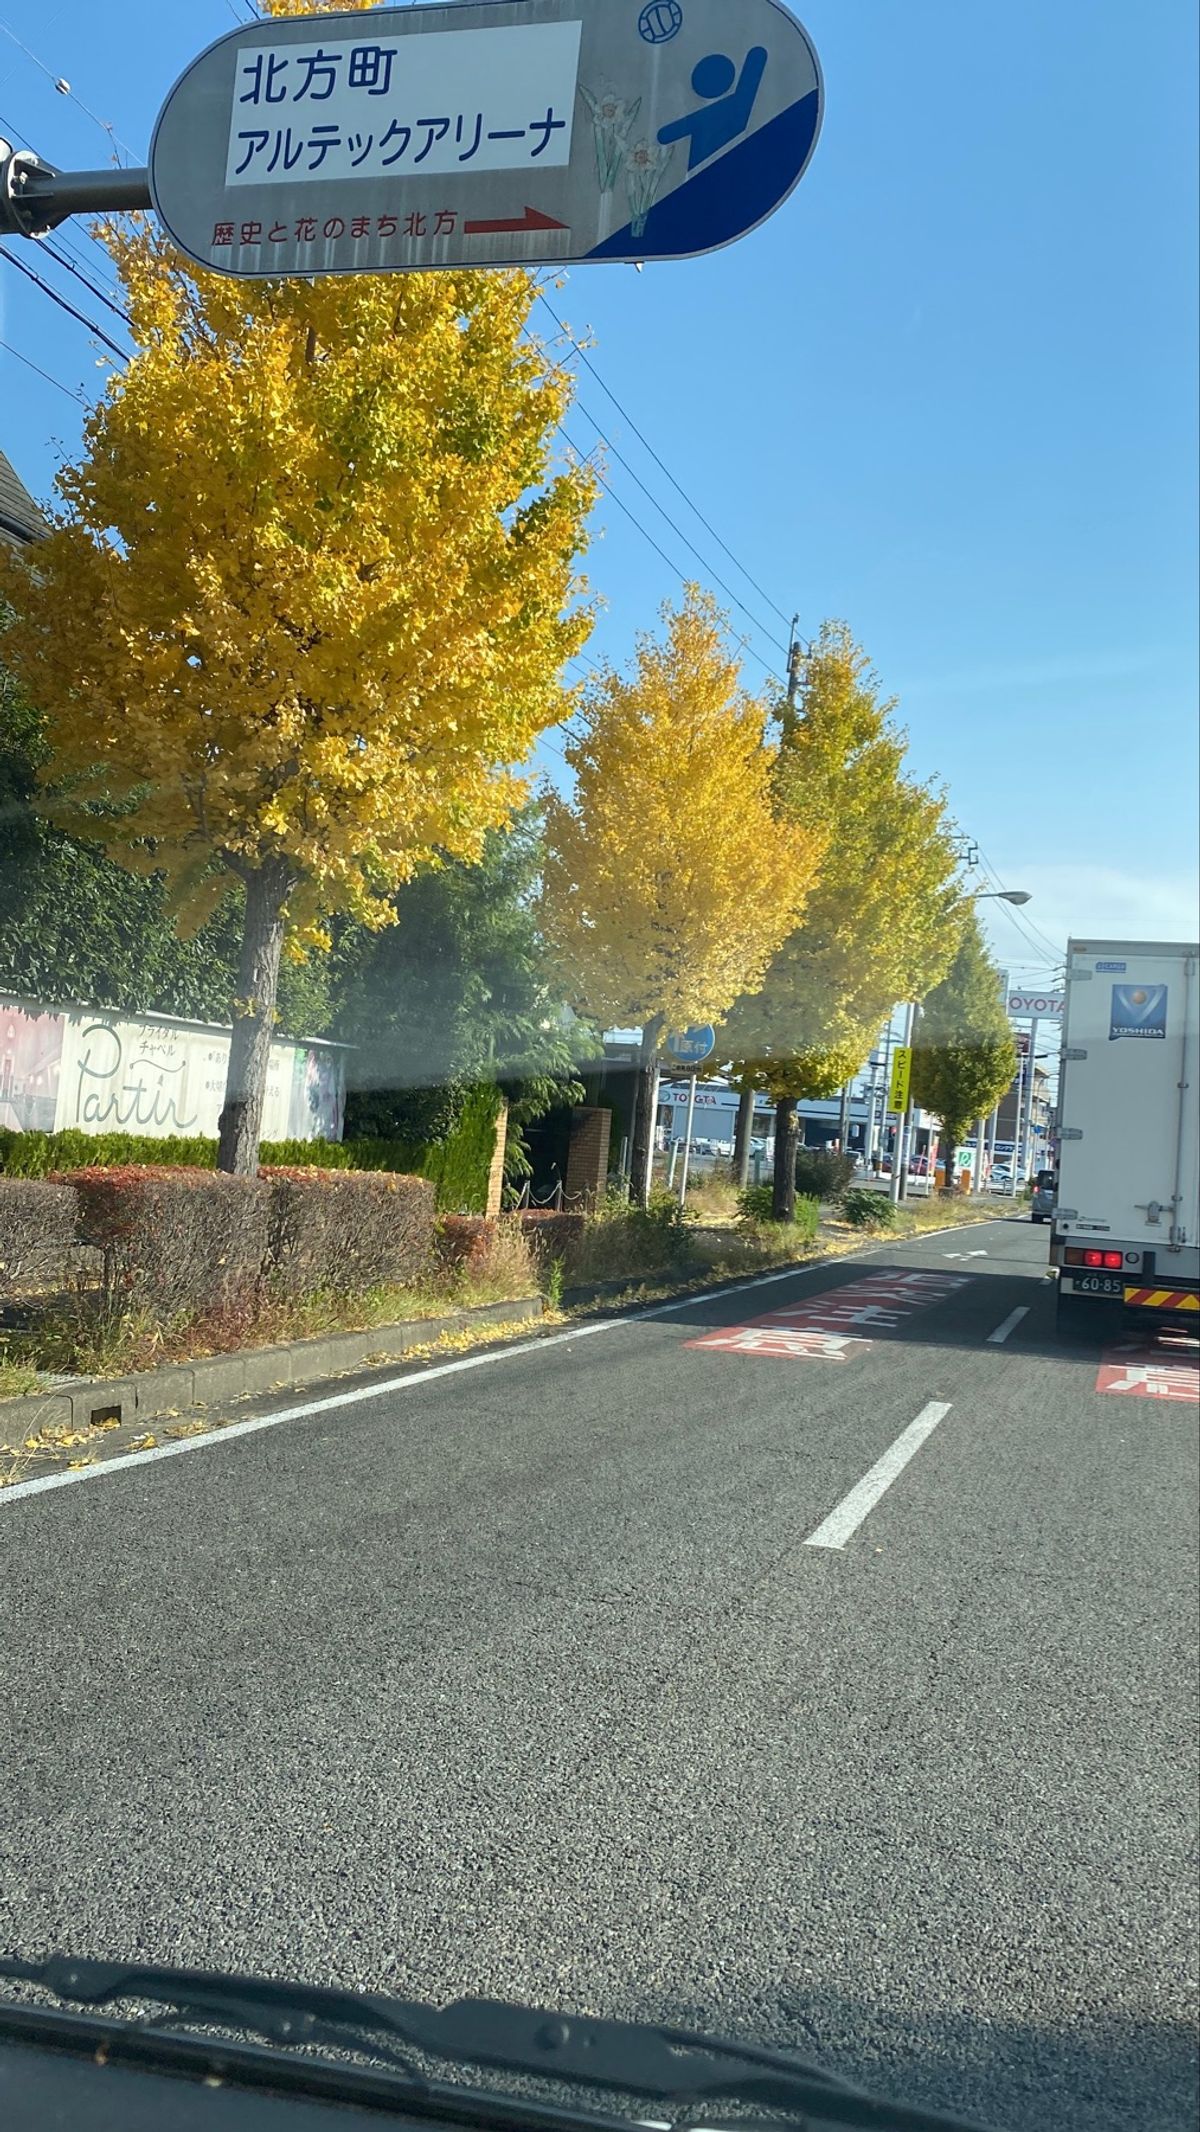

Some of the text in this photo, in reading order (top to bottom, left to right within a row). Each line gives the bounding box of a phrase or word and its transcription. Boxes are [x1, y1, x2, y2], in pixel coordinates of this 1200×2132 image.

[241, 46, 398, 105] 北方町
[236, 108, 566, 175] アルテックアリーナ
[211, 210, 459, 247] 歴史と花のまち北方
[1009, 997, 1065, 1013] OYOTA
[1112, 1027, 1164, 1035] YOSHIDA
[77, 1024, 197, 1129] Partir
[894, 1050, 908, 1110] スピード注意
